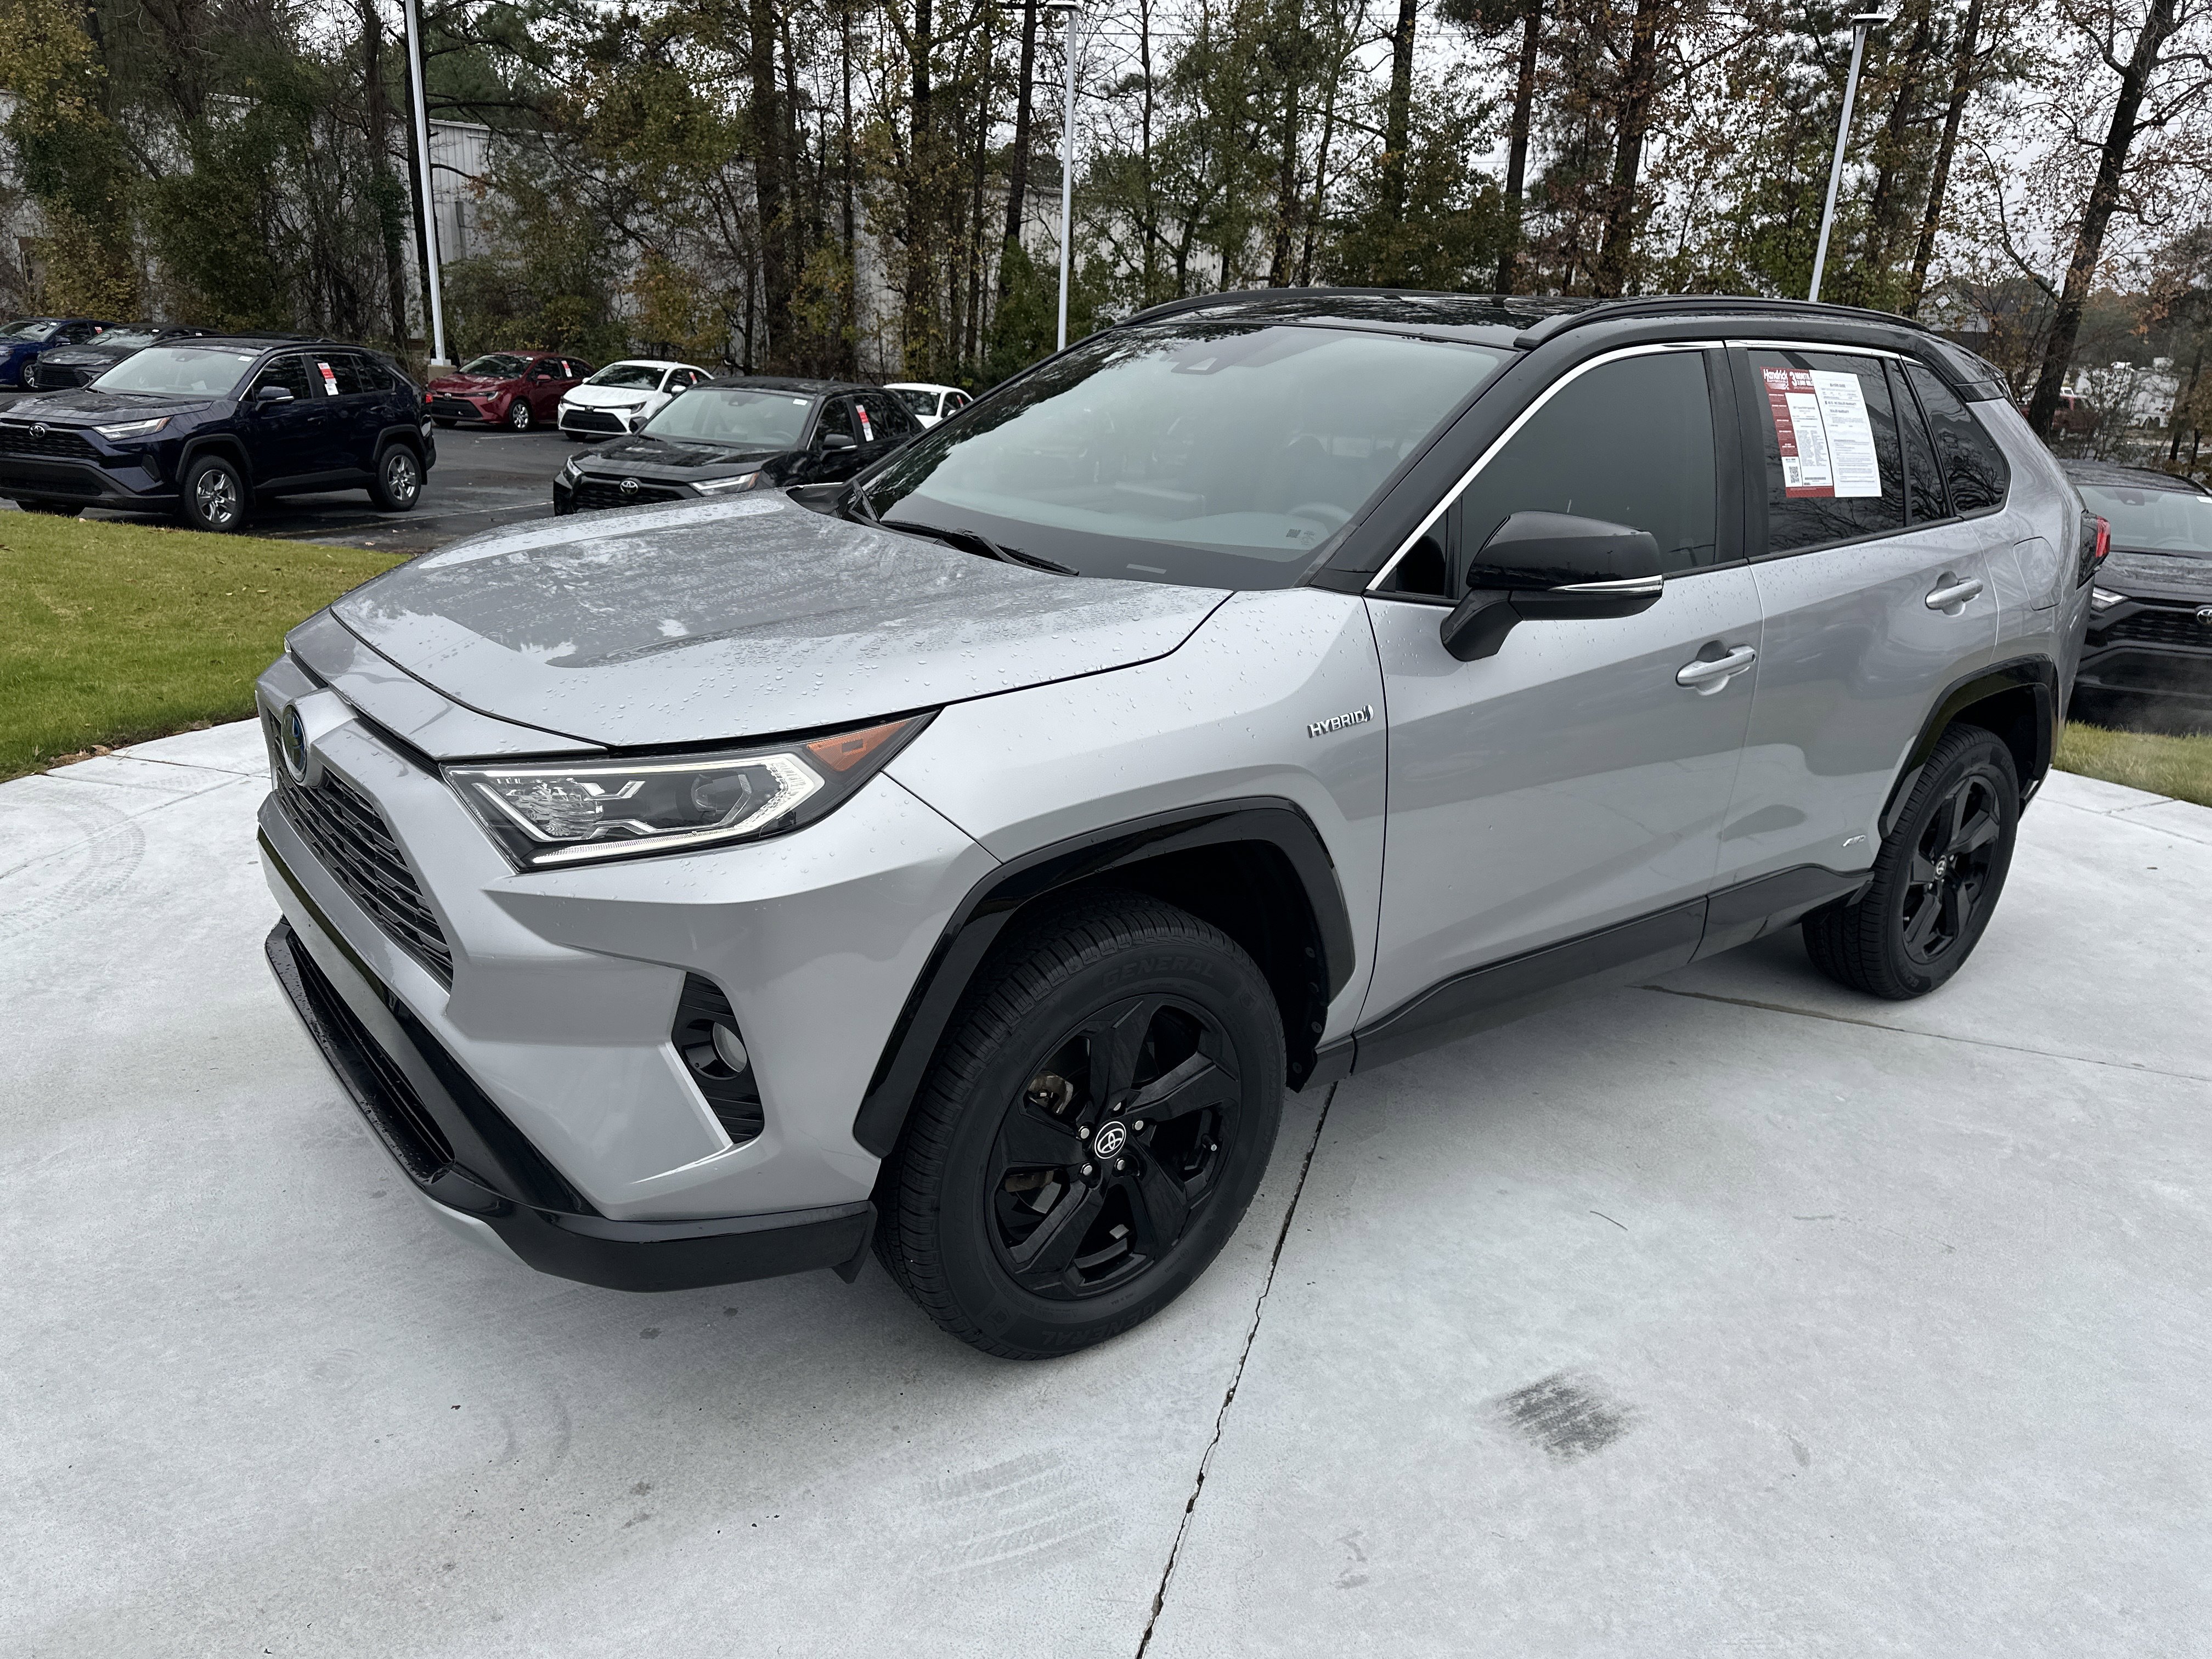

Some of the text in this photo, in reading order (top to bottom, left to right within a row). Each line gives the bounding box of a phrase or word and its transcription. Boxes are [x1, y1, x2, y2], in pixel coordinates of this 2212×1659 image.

[1308, 709, 1366, 738] HYBRID
[1102, 956, 1216, 988] GENERAL
[1040, 1301, 1157, 1346] GENERAL
